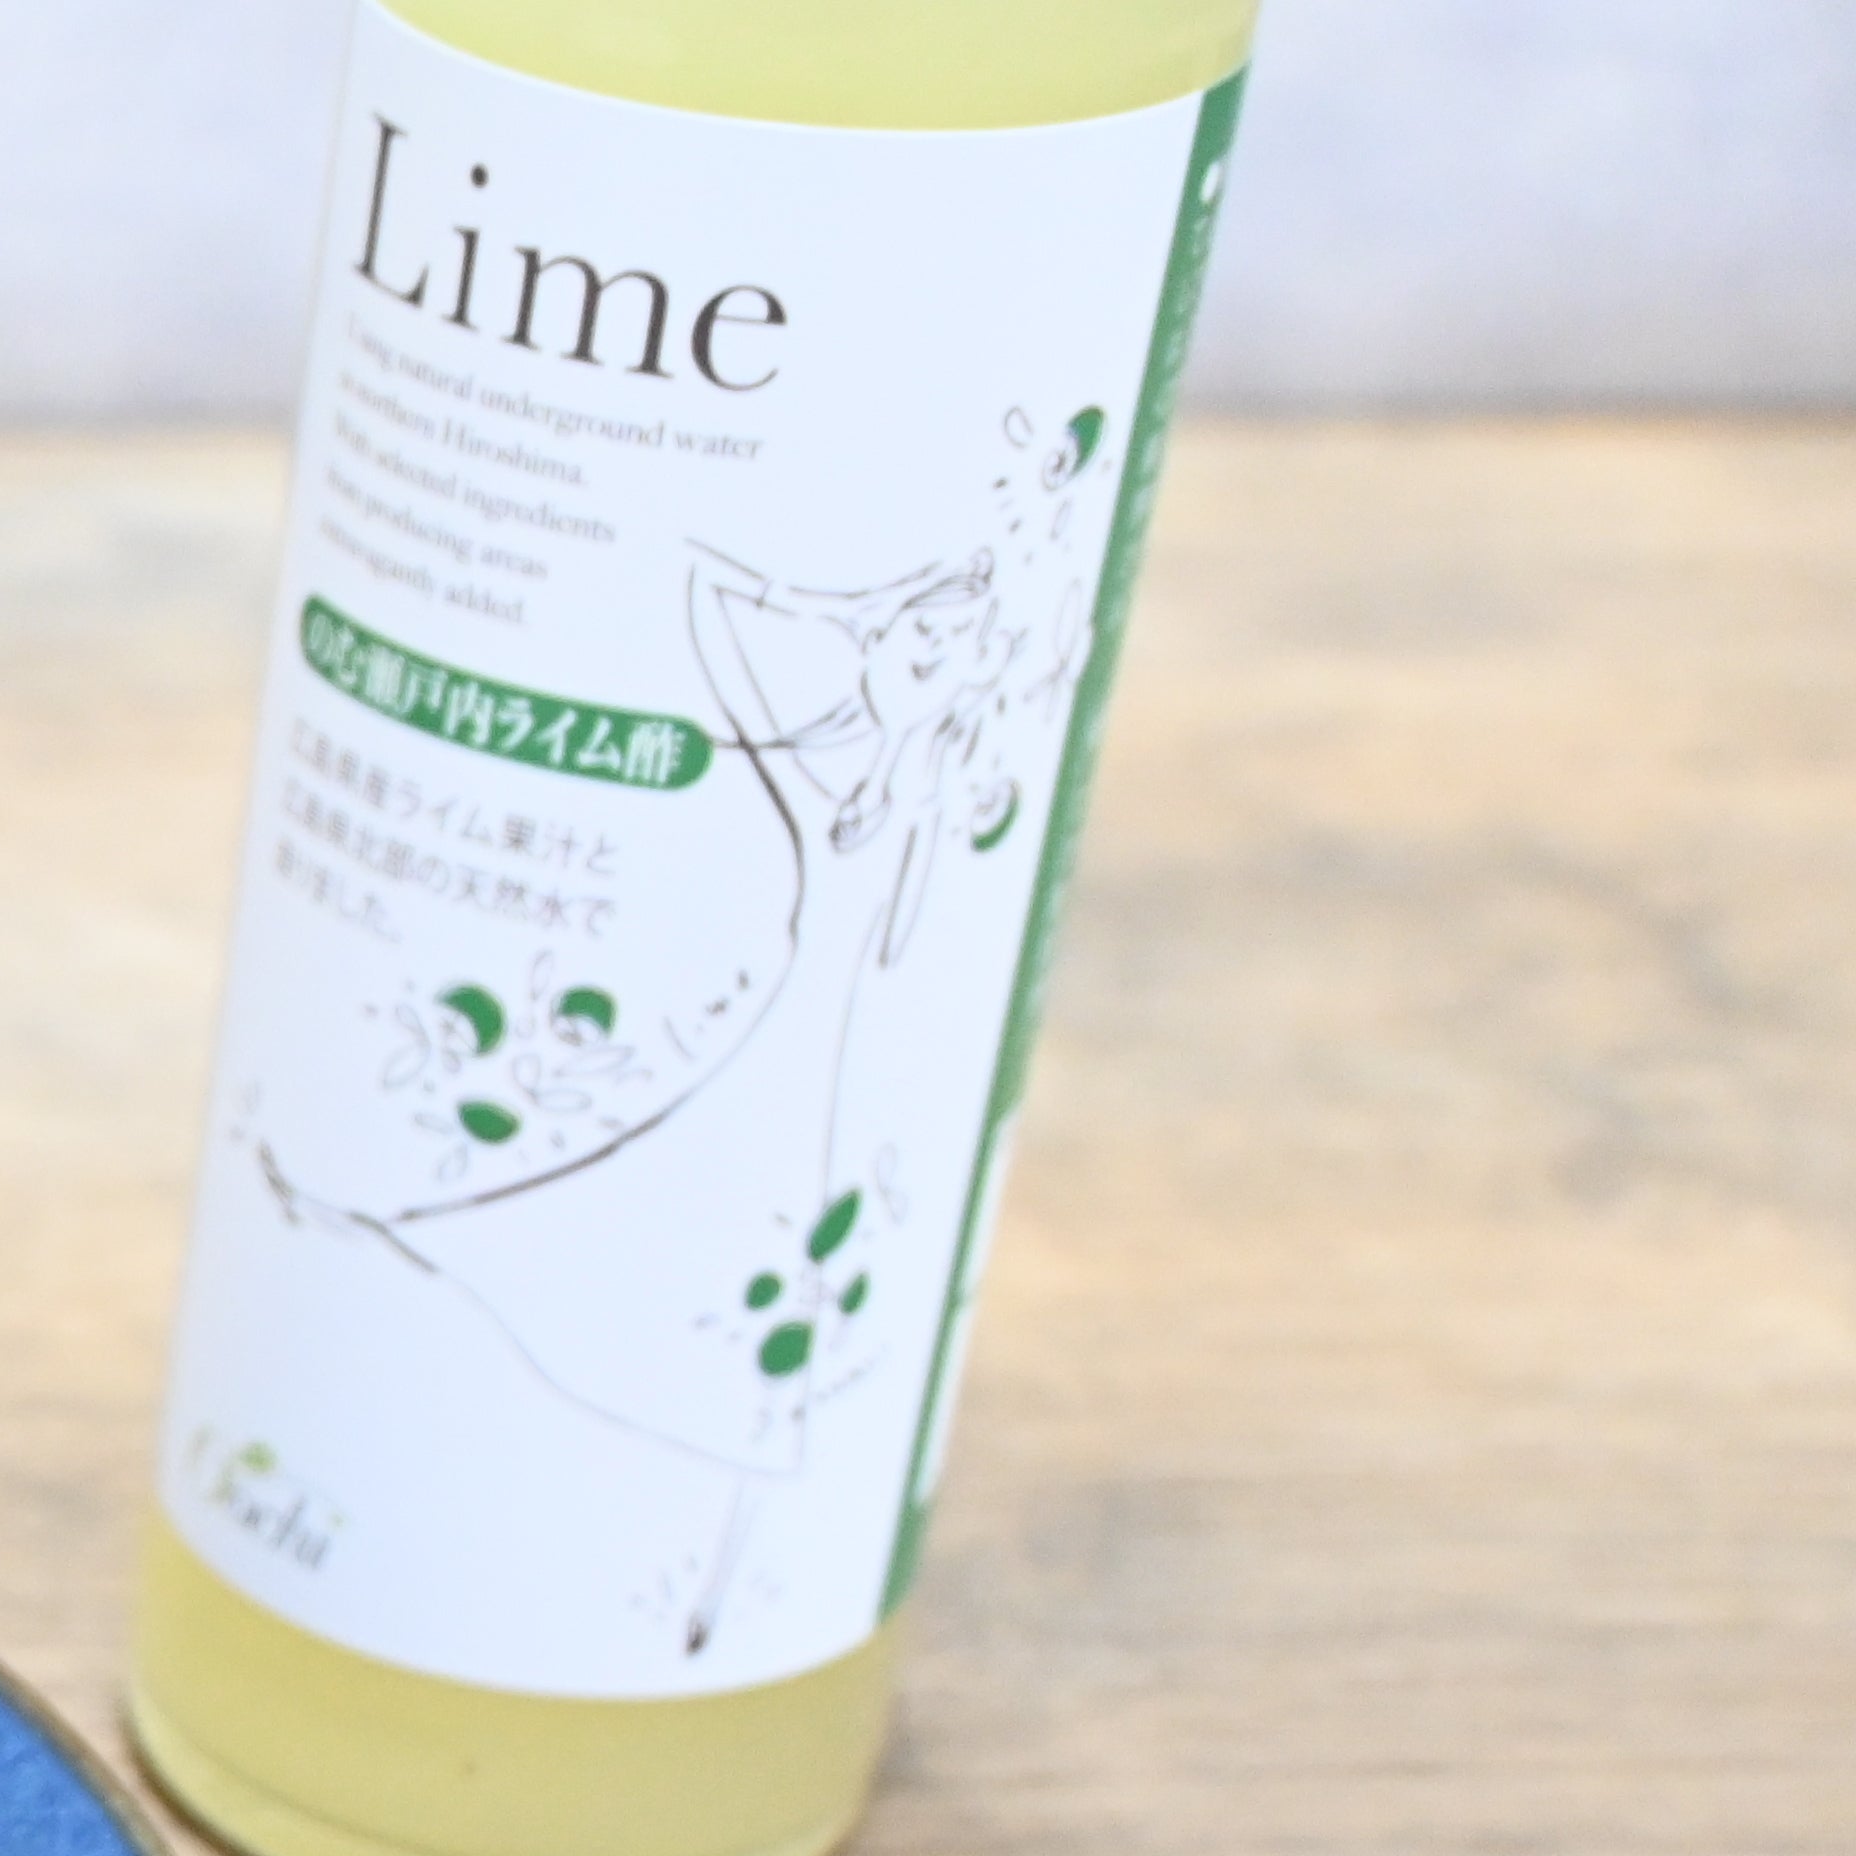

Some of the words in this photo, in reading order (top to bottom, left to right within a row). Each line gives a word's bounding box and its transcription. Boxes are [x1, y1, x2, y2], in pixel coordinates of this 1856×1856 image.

[354, 113, 789, 391] Lime
[398, 352, 474, 400] natural
[480, 387, 665, 448] underground
[672, 426, 764, 460] water
[443, 416, 588, 486] Hiroshima.
[365, 490, 475, 565] producing
[480, 545, 548, 579] areas
[463, 480, 617, 543] ingredients
[307, 610, 685, 784] のむ瀬戸内ライム酢
